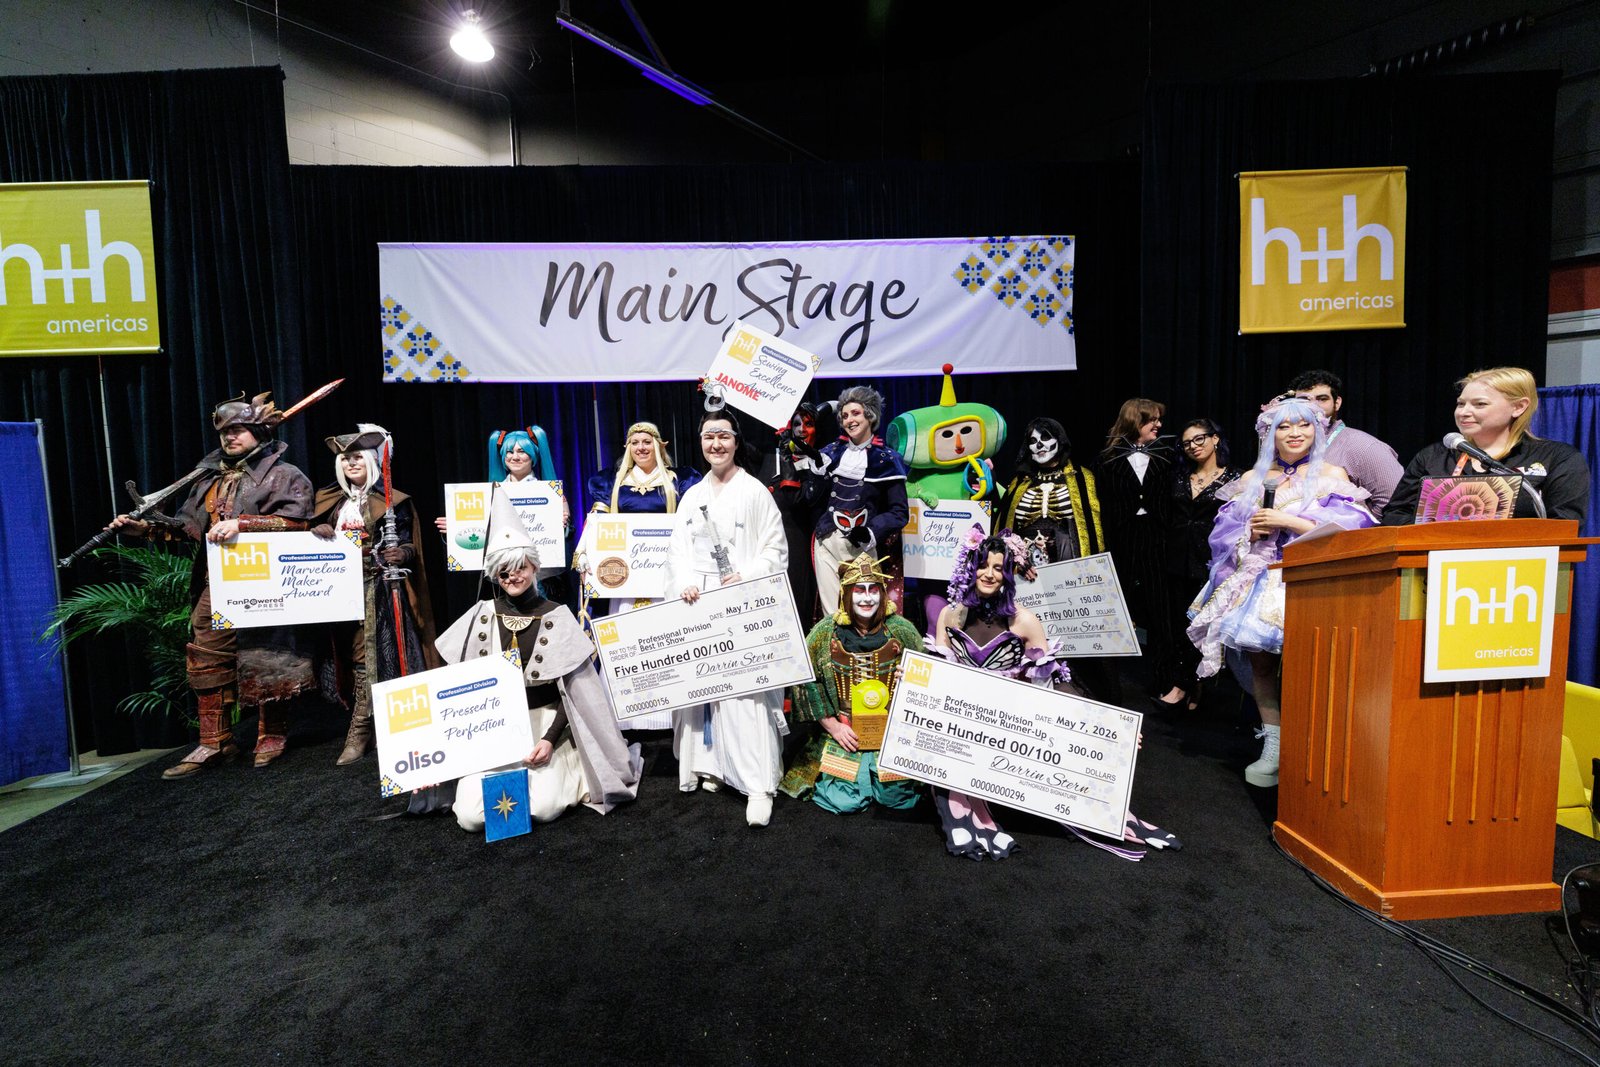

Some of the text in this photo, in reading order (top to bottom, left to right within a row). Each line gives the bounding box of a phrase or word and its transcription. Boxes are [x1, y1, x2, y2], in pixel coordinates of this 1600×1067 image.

[1251, 194, 1394, 285] h+h
[539, 258, 919, 362] Main Stage
[1300, 292, 1394, 311] americas
[47, 314, 148, 334] americas
[752, 355, 788, 380] Sewing
[763, 347, 788, 362] Professional
[787, 358, 806, 370] Division
[715, 373, 761, 401] JANOME
[749, 367, 797, 396] Excellence
[744, 382, 781, 402] Award
[456, 493, 482, 510] h+h
[525, 523, 545, 532] eedle
[926, 521, 955, 535] Joy of
[923, 532, 959, 548] Cosplay
[224, 545, 267, 566] h+h
[903, 544, 953, 558] AMORE
[281, 563, 346, 576] Marvelous
[282, 575, 323, 587] Maker
[1086, 575, 1103, 583] 2026
[283, 585, 333, 598] Award
[1035, 591, 1056, 599] Division
[1080, 595, 1102, 604] 150.00
[1446, 566, 1537, 626] h+h
[726, 606, 742, 615] May
[755, 595, 776, 608] 2026
[1044, 611, 1061, 620] Fifty
[1063, 607, 1090, 619] 00/100
[638, 623, 712, 646] Professional Division
[727, 619, 773, 637] $ 500.00
[1048, 621, 1105, 634] Darrin Stern
[640, 643, 656, 653] Best
[666, 636, 686, 646] Show
[764, 632, 790, 643] DOLLARS
[610, 653, 628, 662] ORDER
[614, 640, 735, 678] Five Hundred 00/100
[1475, 646, 1534, 659] americas
[696, 652, 775, 676] Darrin Stern
[907, 660, 930, 678] h+h
[439, 680, 496, 698] Professional Division
[756, 675, 769, 685] 456
[389, 688, 428, 717] h+h
[906, 696, 928, 708] ORDER
[907, 690, 942, 704] PAY TO THE
[440, 696, 500, 720] Pressed to
[945, 695, 1033, 727] Professional Division
[943, 702, 1047, 740] Best in Show Runner-Up
[1119, 714, 1134, 723] 1449
[444, 718, 506, 740] Perfection
[904, 709, 1061, 765] Three Hundred 00/100
[1056, 716, 1076, 730] May
[1080, 721, 1089, 734] 7,
[1092, 725, 1118, 740] 2026
[934, 735, 950, 743] Cutlery
[923, 744, 946, 753] Exhibition
[945, 747, 972, 758] Competition
[1048, 736, 1104, 761] $ 300.00
[394, 750, 446, 774] oliso
[990, 755, 1090, 795] Darrin Stern
[1085, 767, 1117, 782] DOLLARS
[893, 755, 1071, 816] 00000000156 00000000296 456
[1019, 780, 1078, 801] AUTHORIZED SIGNATURE
